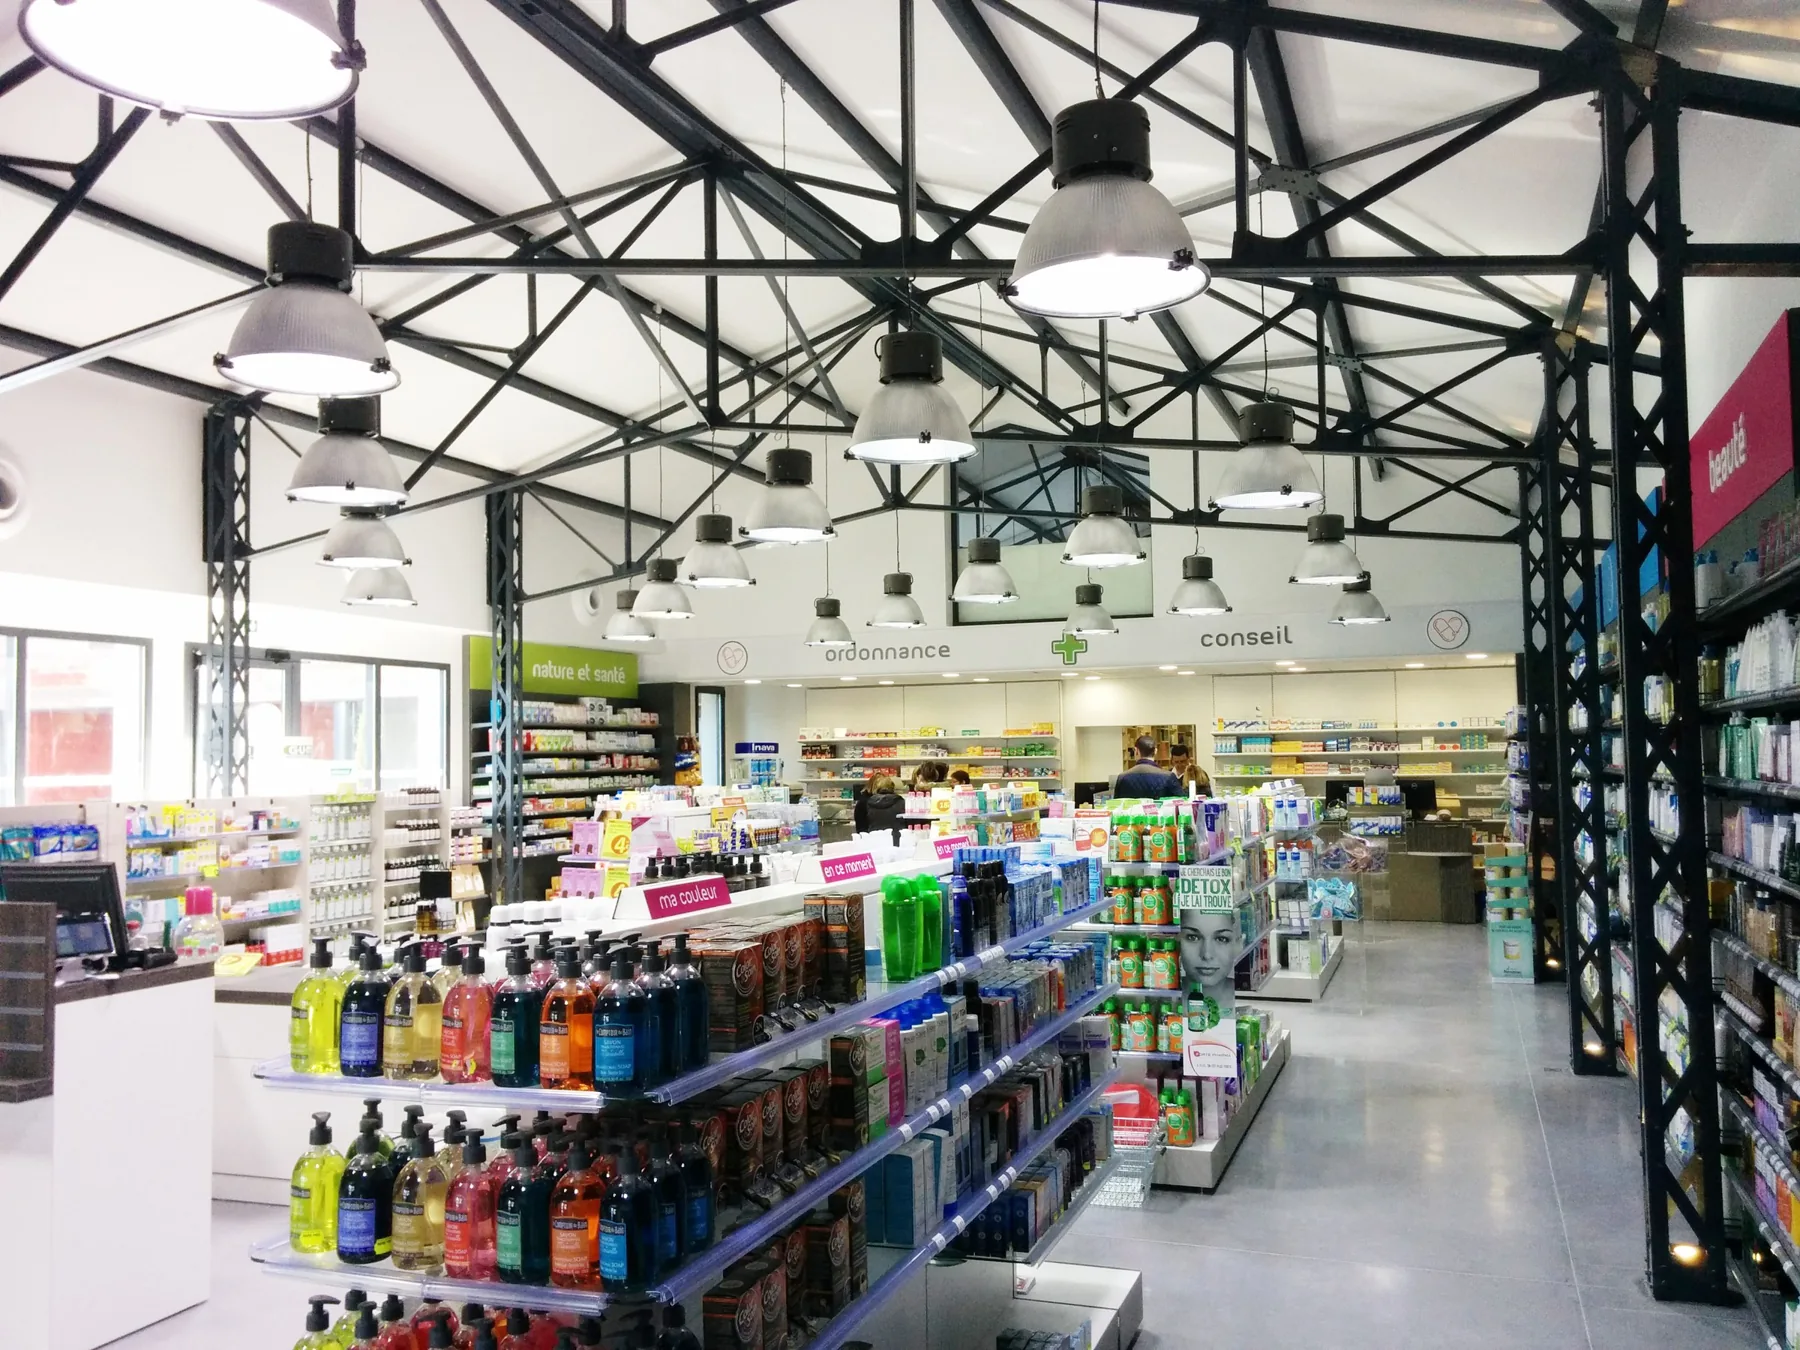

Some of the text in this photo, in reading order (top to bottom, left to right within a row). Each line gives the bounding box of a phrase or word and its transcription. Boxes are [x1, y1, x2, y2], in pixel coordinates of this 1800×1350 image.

[1200, 625, 1293, 647] conseil
[825, 643, 951, 662] ordonnance
[532, 660, 626, 684] nature et santé
[824, 857, 873, 877] en ce moment
[1181, 878, 1231, 894] DETOX
[659, 885, 717, 909] ma couleur
[1181, 895, 1189, 907] JE
